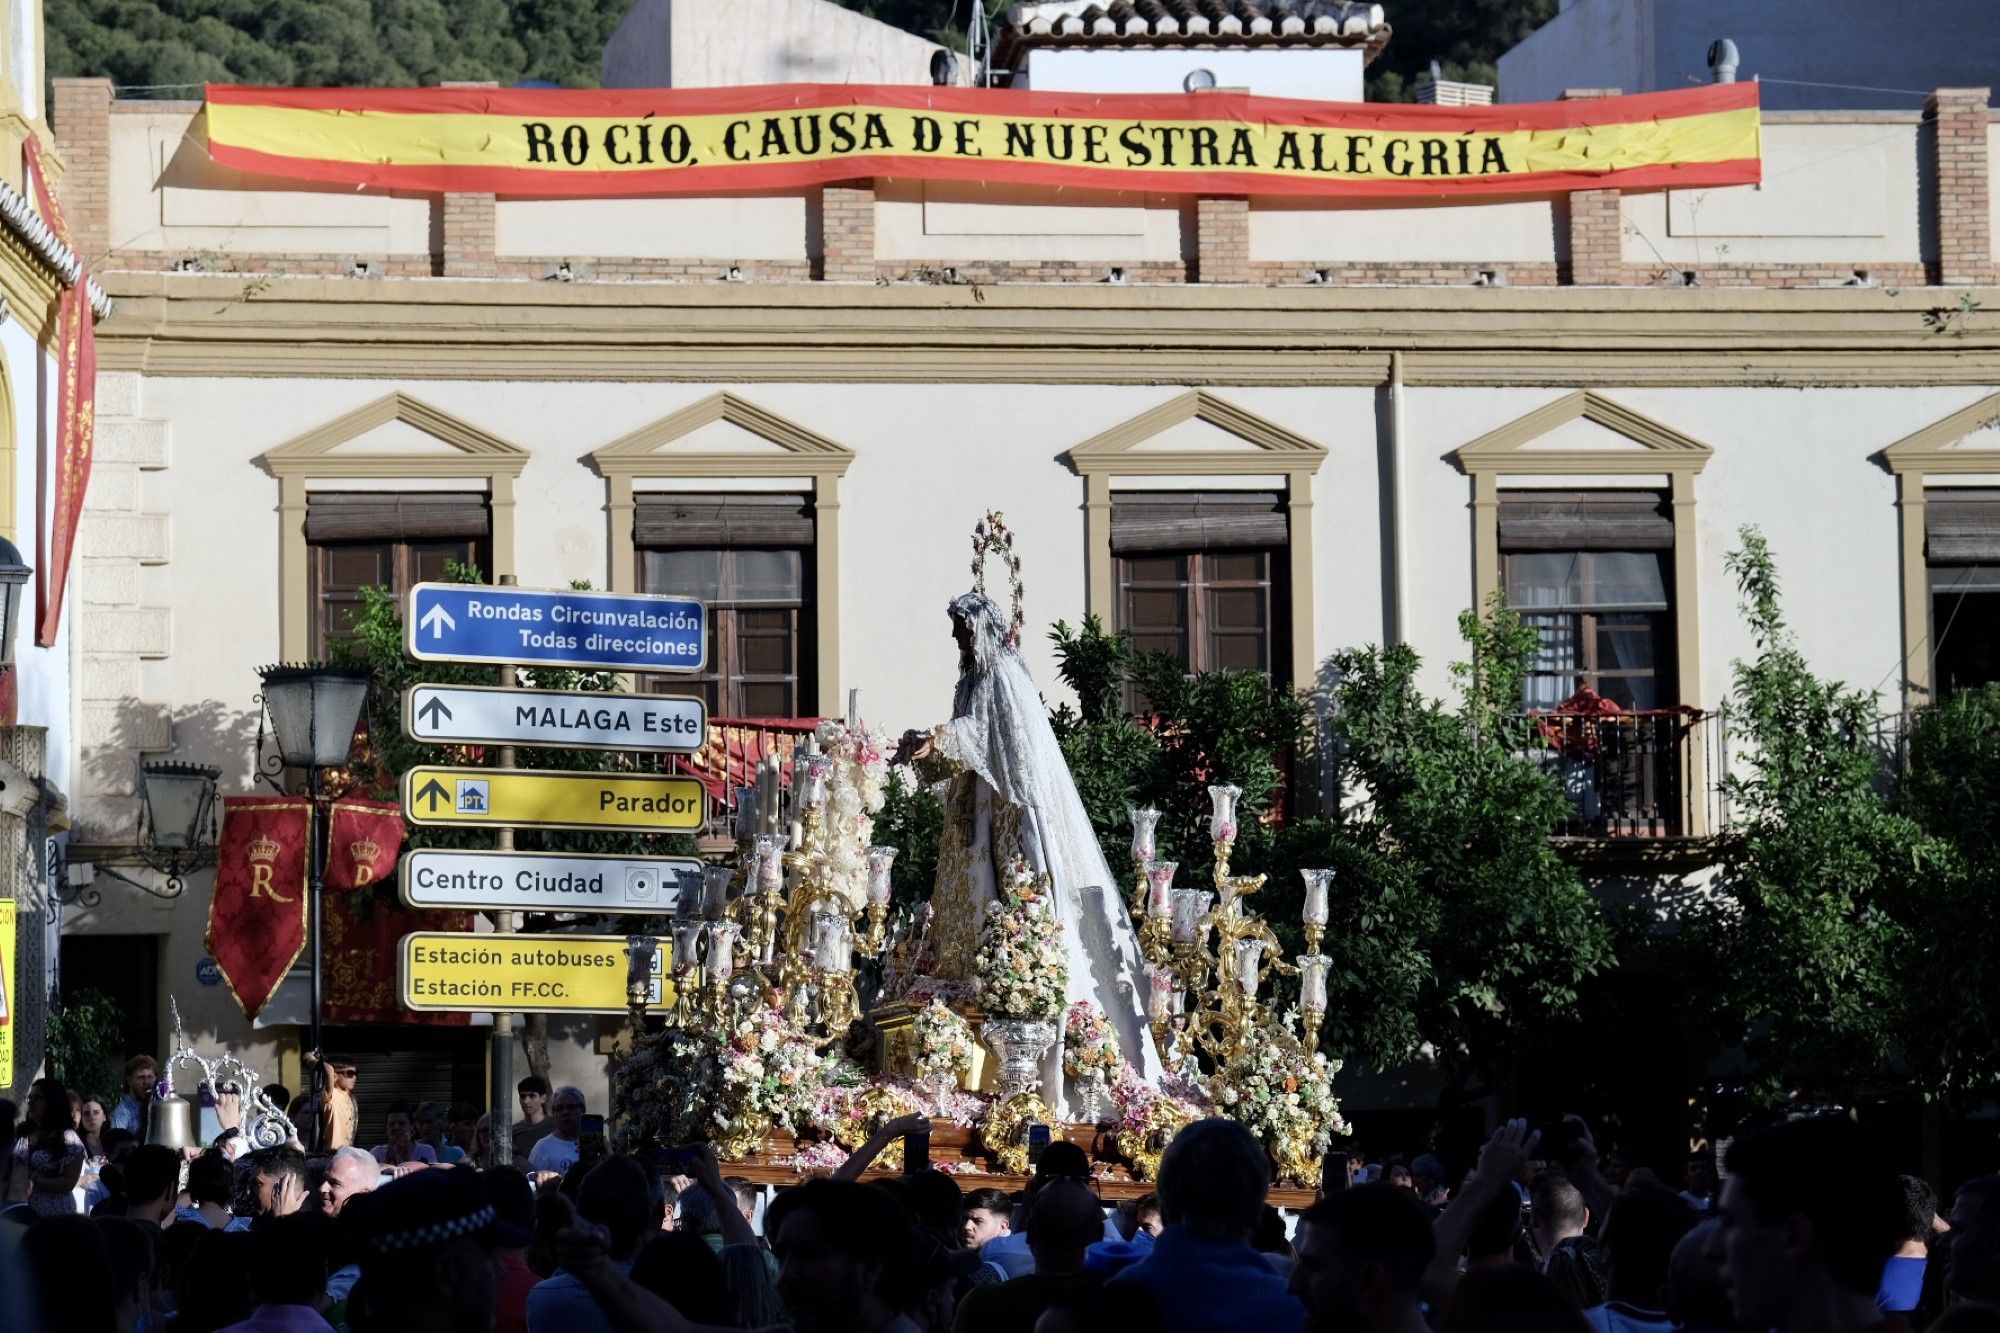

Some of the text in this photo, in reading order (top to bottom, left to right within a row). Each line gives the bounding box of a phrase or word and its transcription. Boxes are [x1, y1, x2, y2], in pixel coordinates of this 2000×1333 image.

[522, 110, 1510, 177] ROCÍO, CAUSA DE NUESTRA ALEGRÍA
[468, 600, 698, 630] Rondas Circunvalación
[519, 629, 698, 656] Todas direcciones
[516, 706, 698, 734] MALAGA Este
[600, 790, 697, 814] Parador
[249, 864, 293, 902] R
[417, 867, 603, 894] Centro Ciudad
[414, 947, 615, 967] Estación autobuses
[414, 978, 569, 998] Estación FF.CC.
